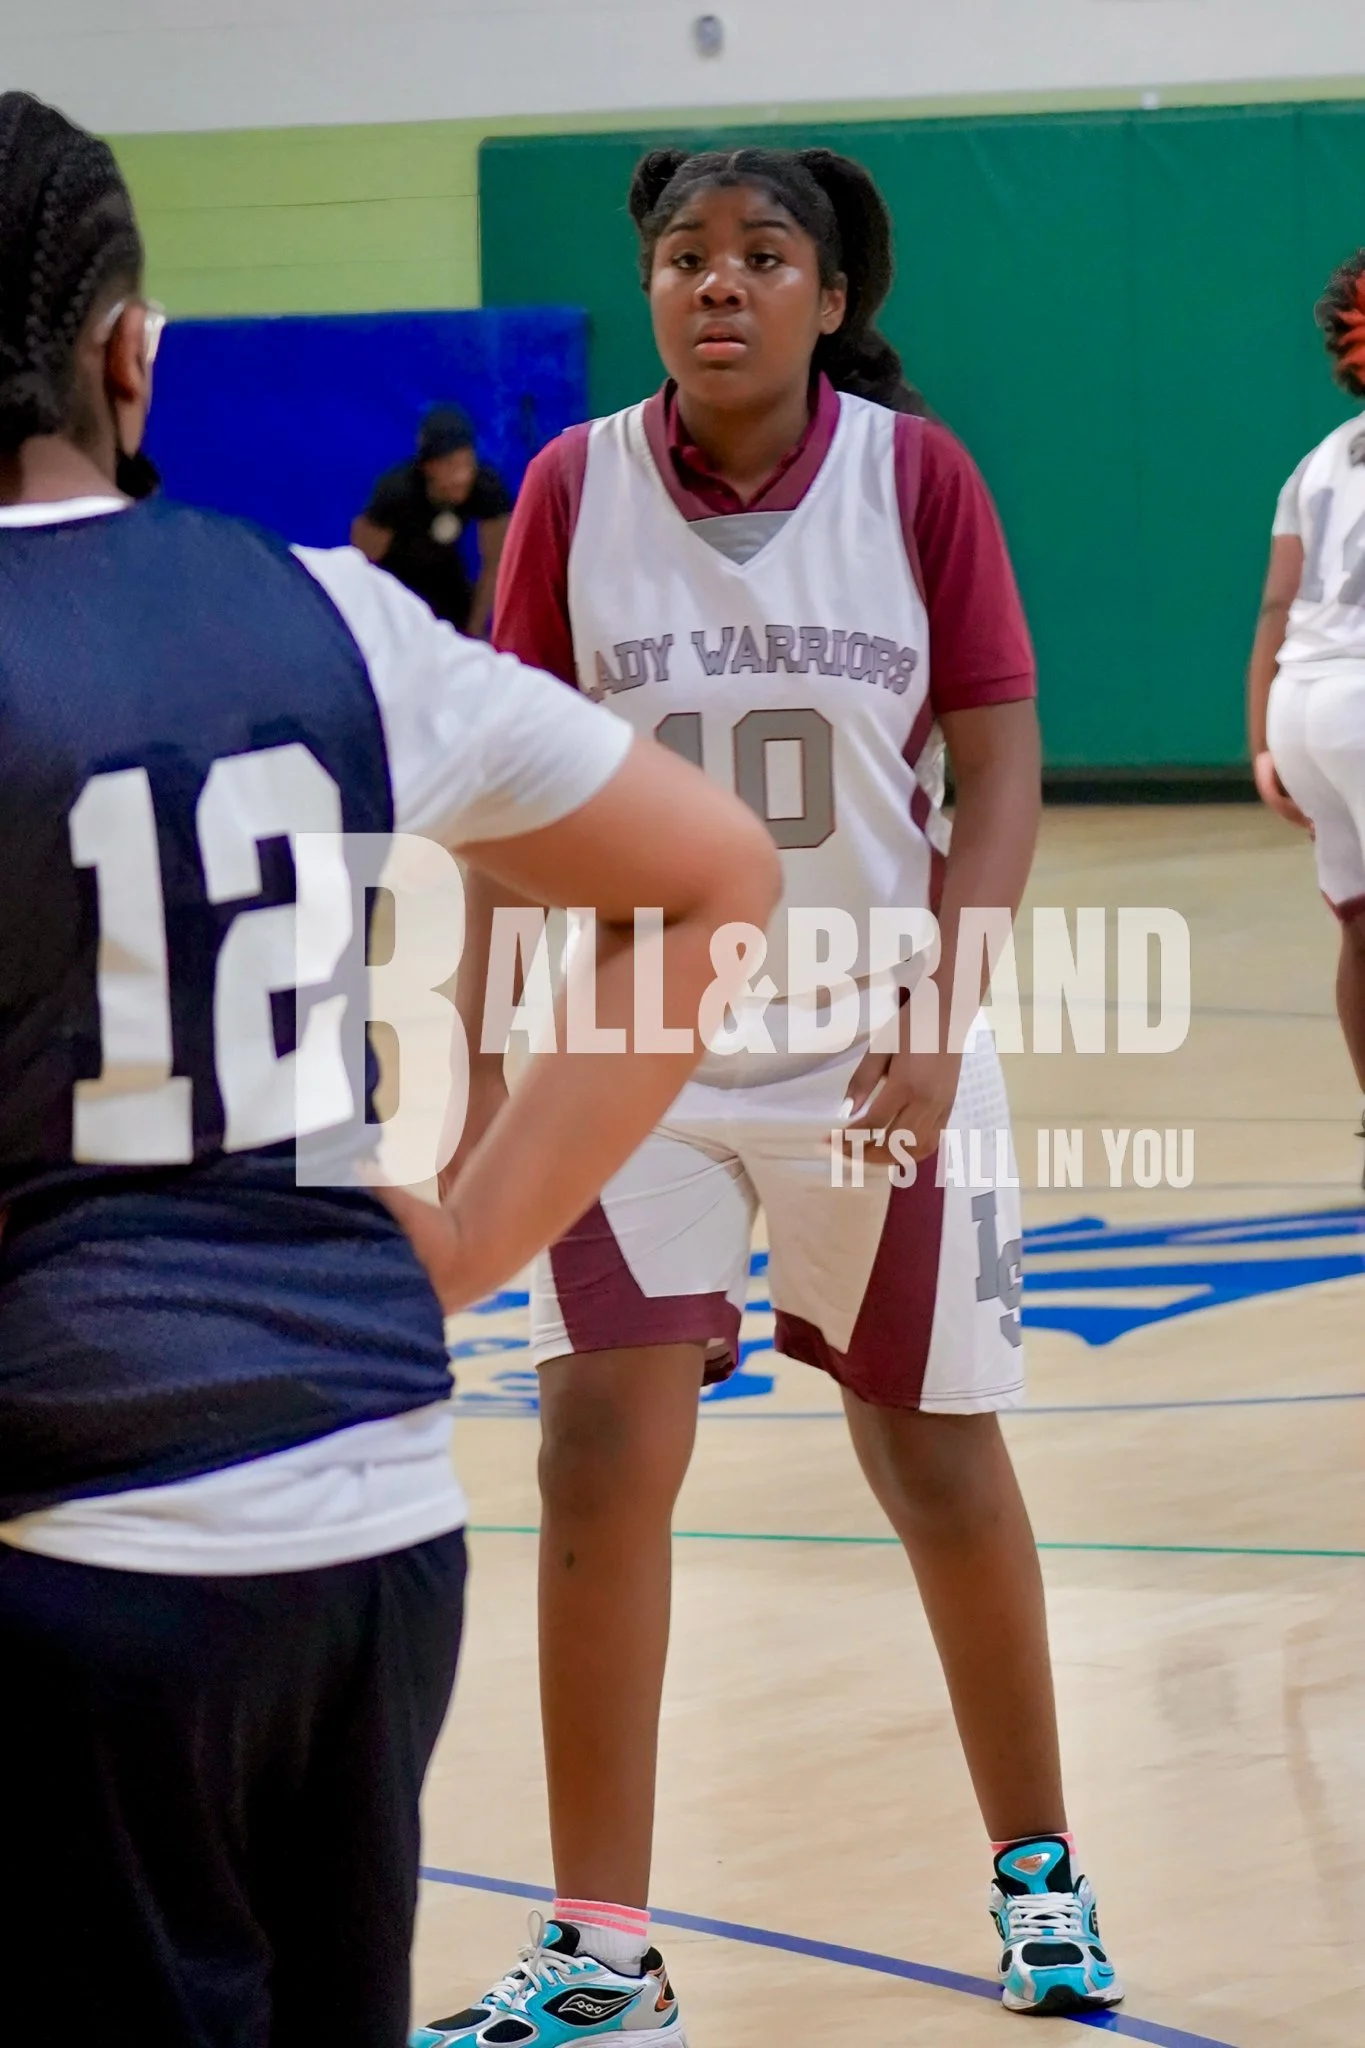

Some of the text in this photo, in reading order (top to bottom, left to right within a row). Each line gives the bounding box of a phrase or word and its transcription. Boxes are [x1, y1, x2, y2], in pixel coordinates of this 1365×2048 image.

[585, 624, 918, 703] ADY WARRIORS
[69, 742, 355, 1166] 12
